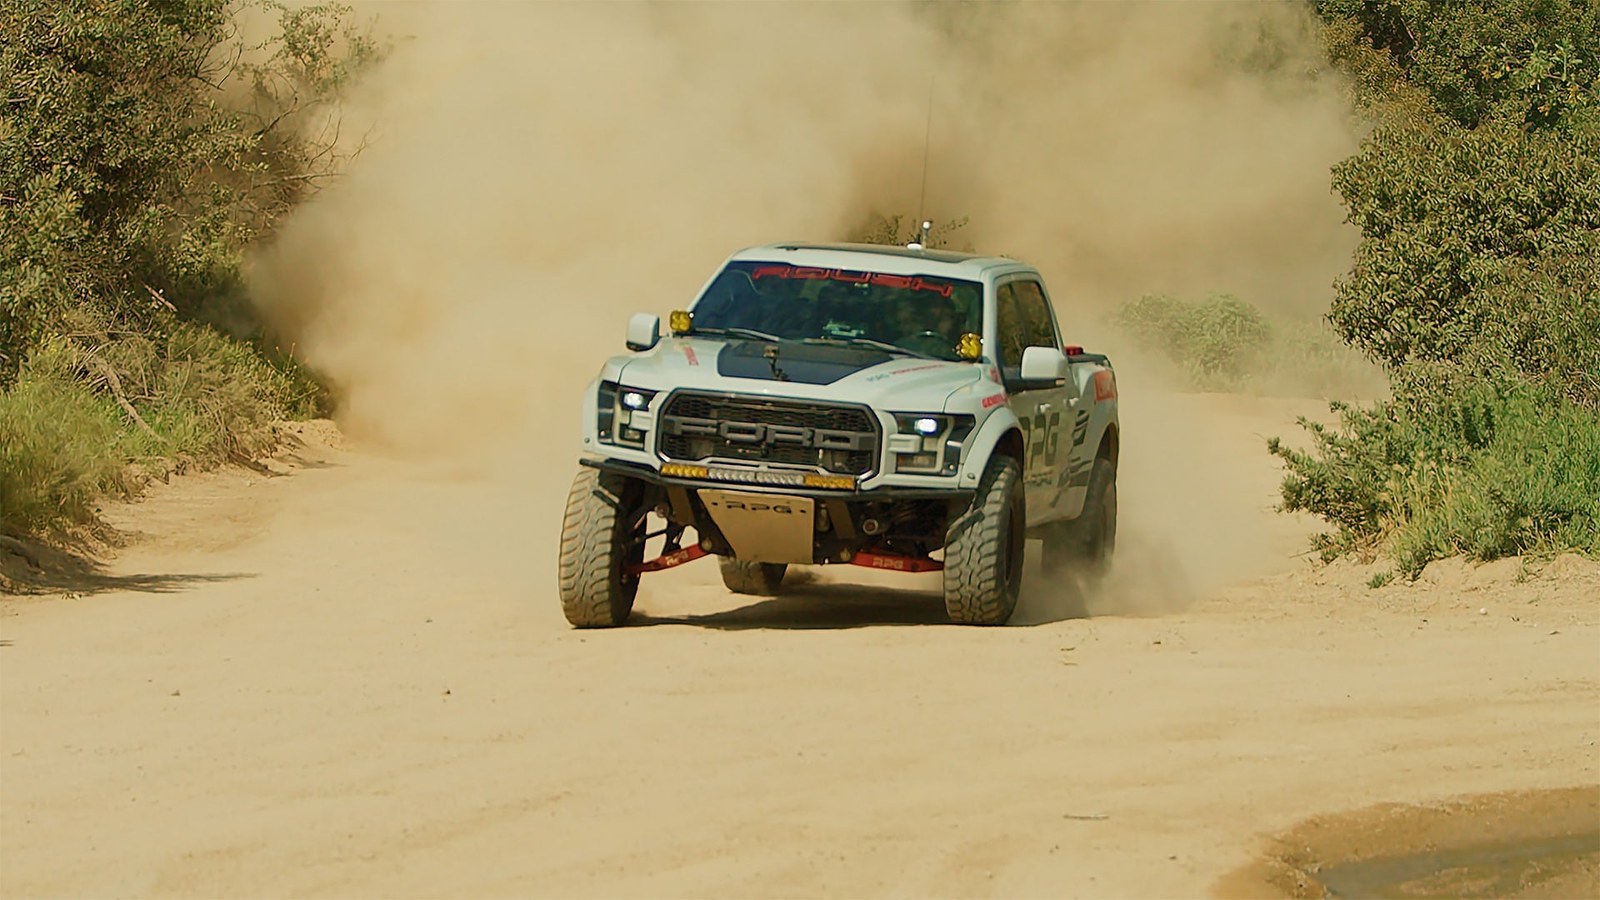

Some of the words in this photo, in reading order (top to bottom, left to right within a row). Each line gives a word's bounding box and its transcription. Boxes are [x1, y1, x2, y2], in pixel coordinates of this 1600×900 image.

[752, 265, 953, 297] ROUSH
[670, 415, 862, 450] FORD
[725, 501, 793, 515] RPG
[872, 558, 904, 569] RPG
